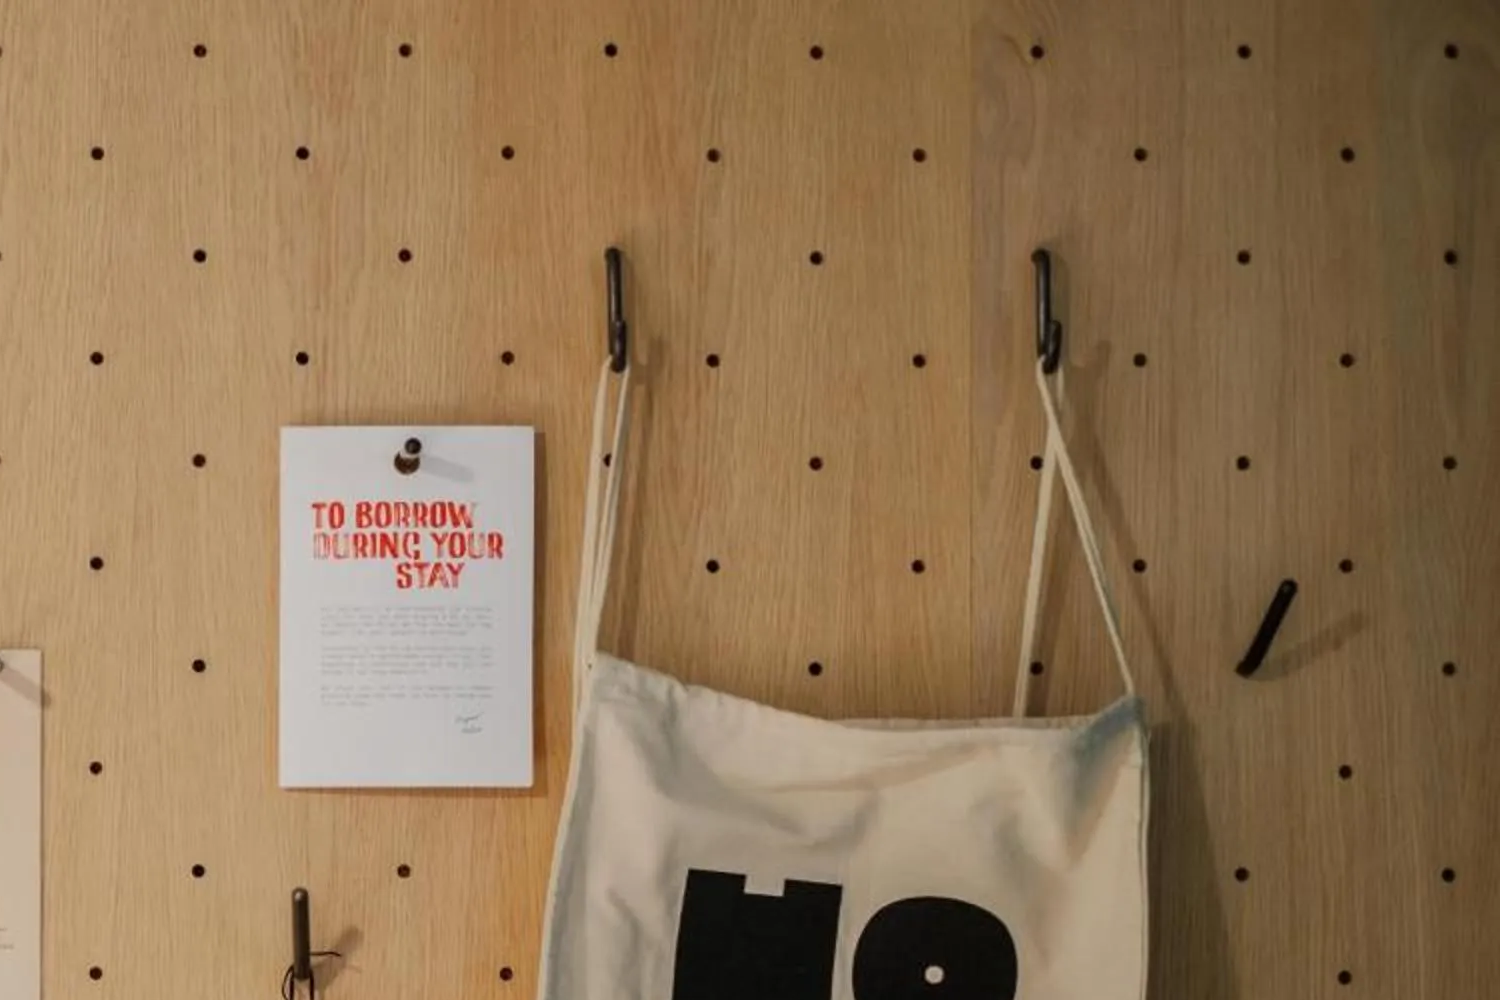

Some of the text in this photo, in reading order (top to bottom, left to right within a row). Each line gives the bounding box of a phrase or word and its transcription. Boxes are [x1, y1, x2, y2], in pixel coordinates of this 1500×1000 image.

[311, 501, 474, 530] TO BORROW
[312, 532, 504, 561] DURING YOUR
[396, 562, 465, 589] STAY
